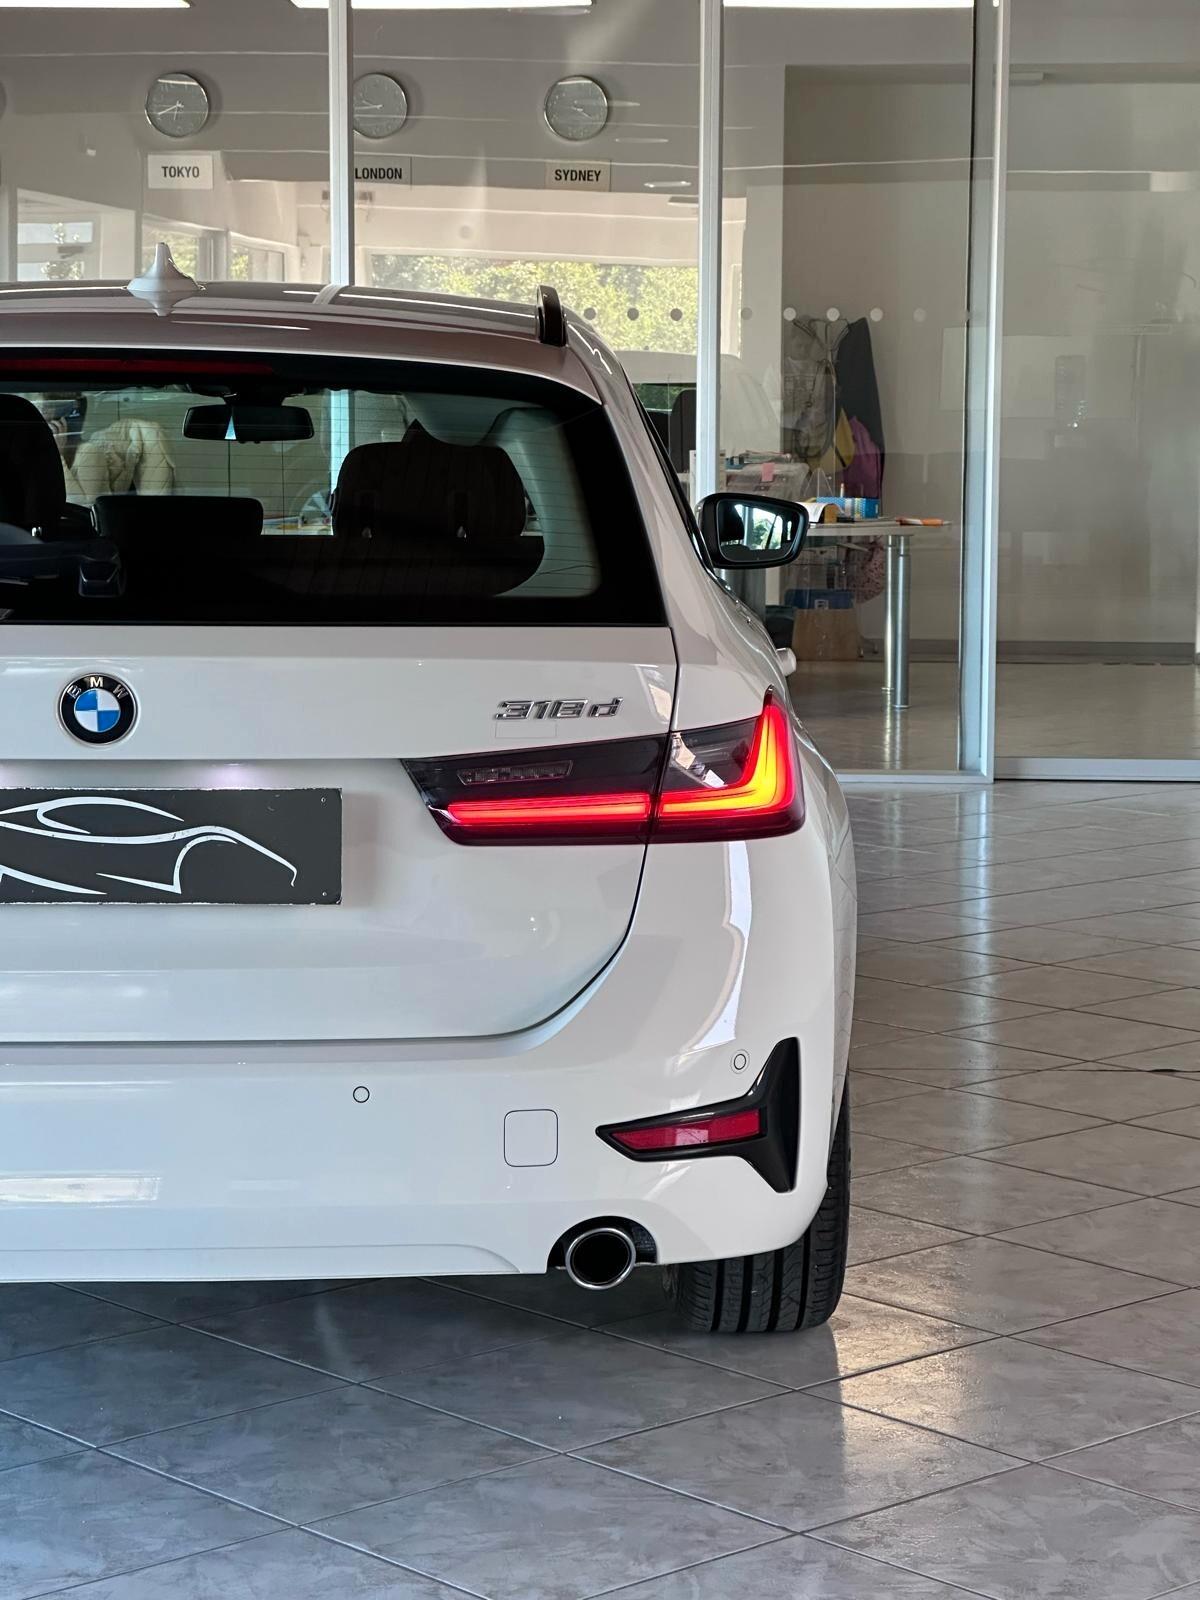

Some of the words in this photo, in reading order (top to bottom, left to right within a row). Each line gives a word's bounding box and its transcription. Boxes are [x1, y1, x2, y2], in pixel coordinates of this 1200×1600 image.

[161, 166, 200, 178] TOKYO
[354, 167, 402, 180] LONDON
[554, 168, 602, 182] SYDNEY
[66, 676, 129, 699] BMW
[494, 697, 623, 720] 318d
